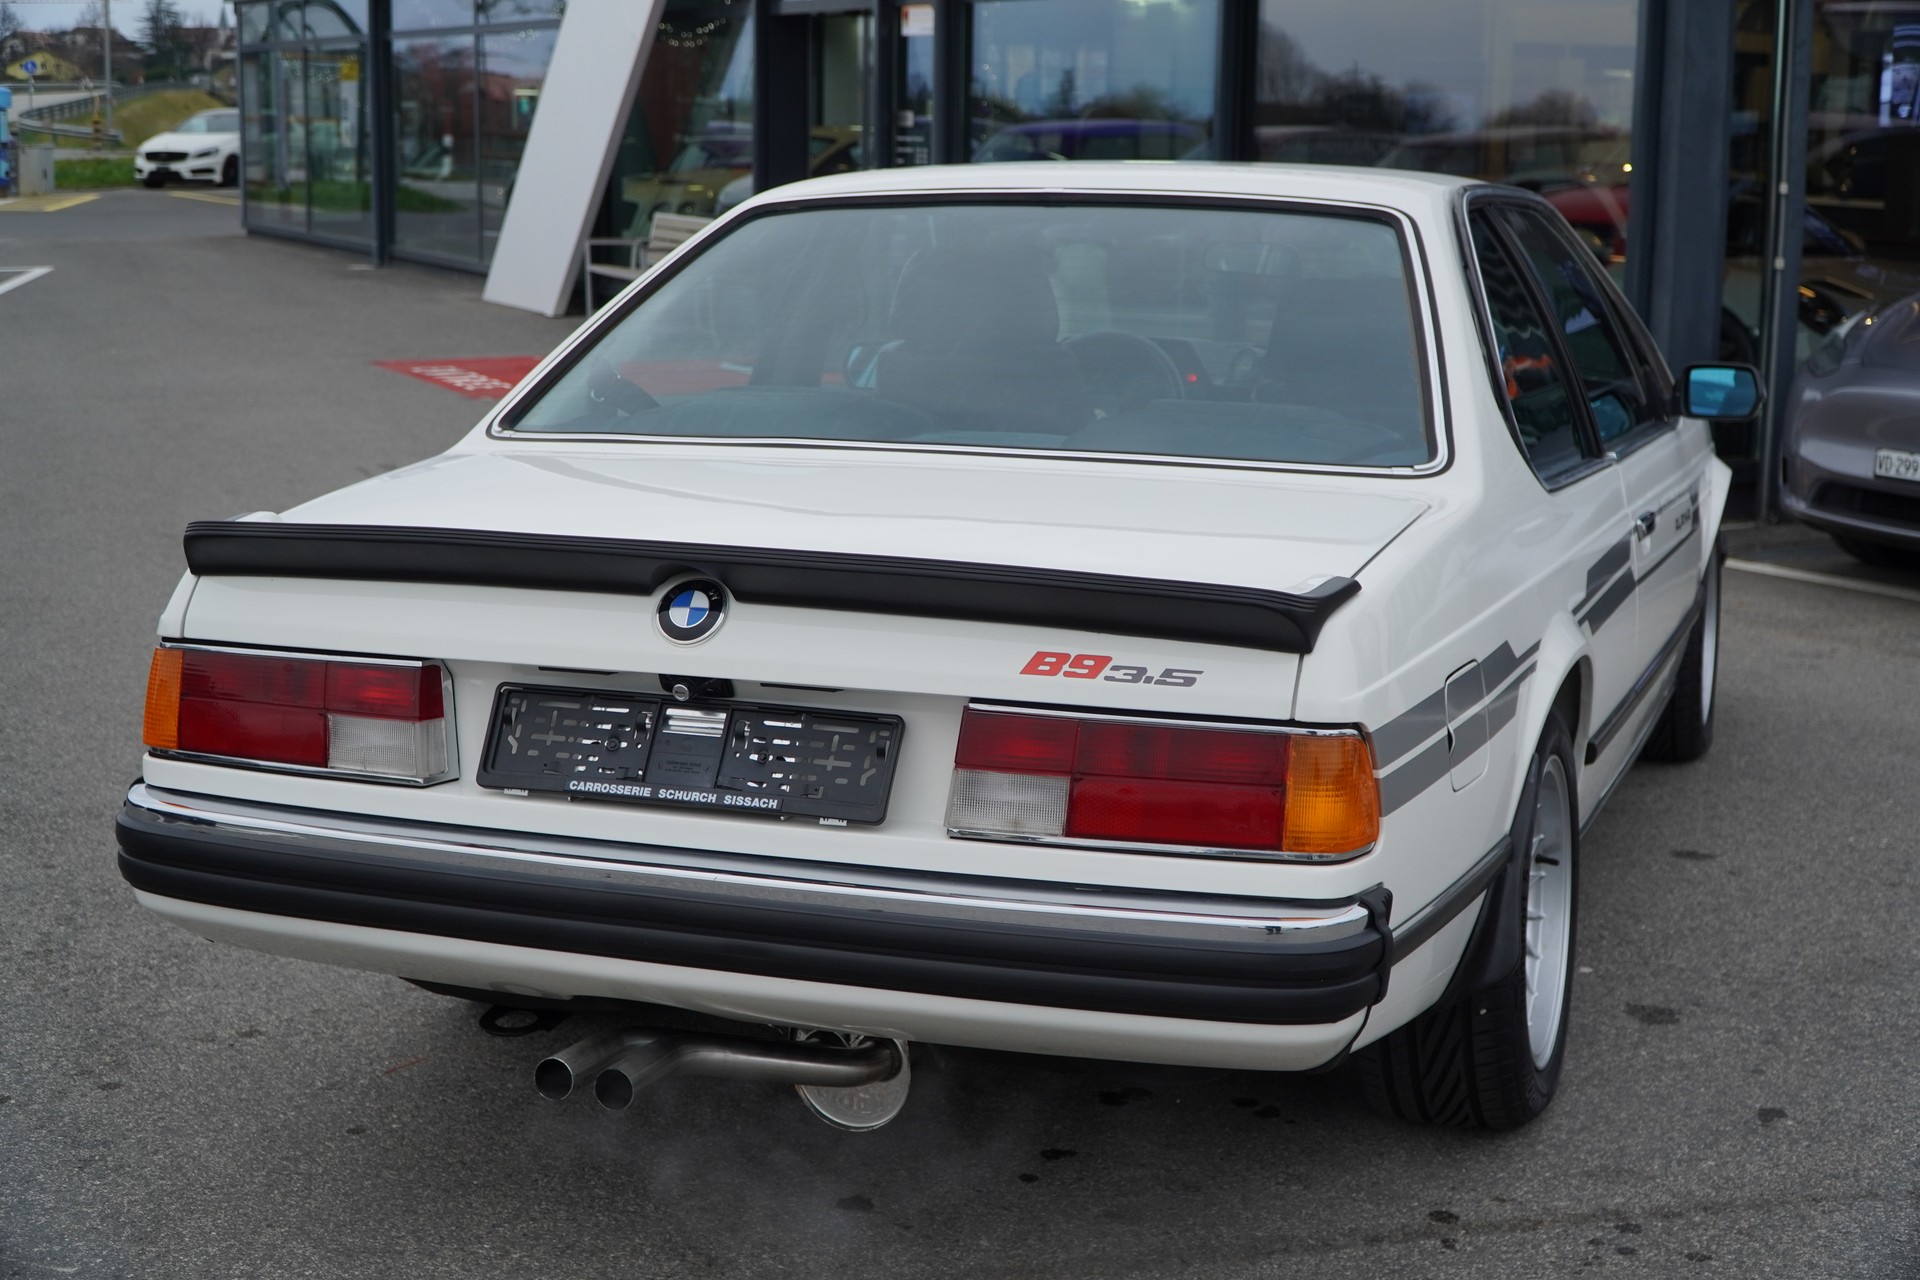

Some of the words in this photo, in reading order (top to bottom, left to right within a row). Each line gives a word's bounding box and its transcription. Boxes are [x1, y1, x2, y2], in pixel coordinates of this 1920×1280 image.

[569, 780, 652, 797] CARROSSERIE
[658, 788, 717, 803] SCHURCH
[723, 795, 778, 809] SISSACH
